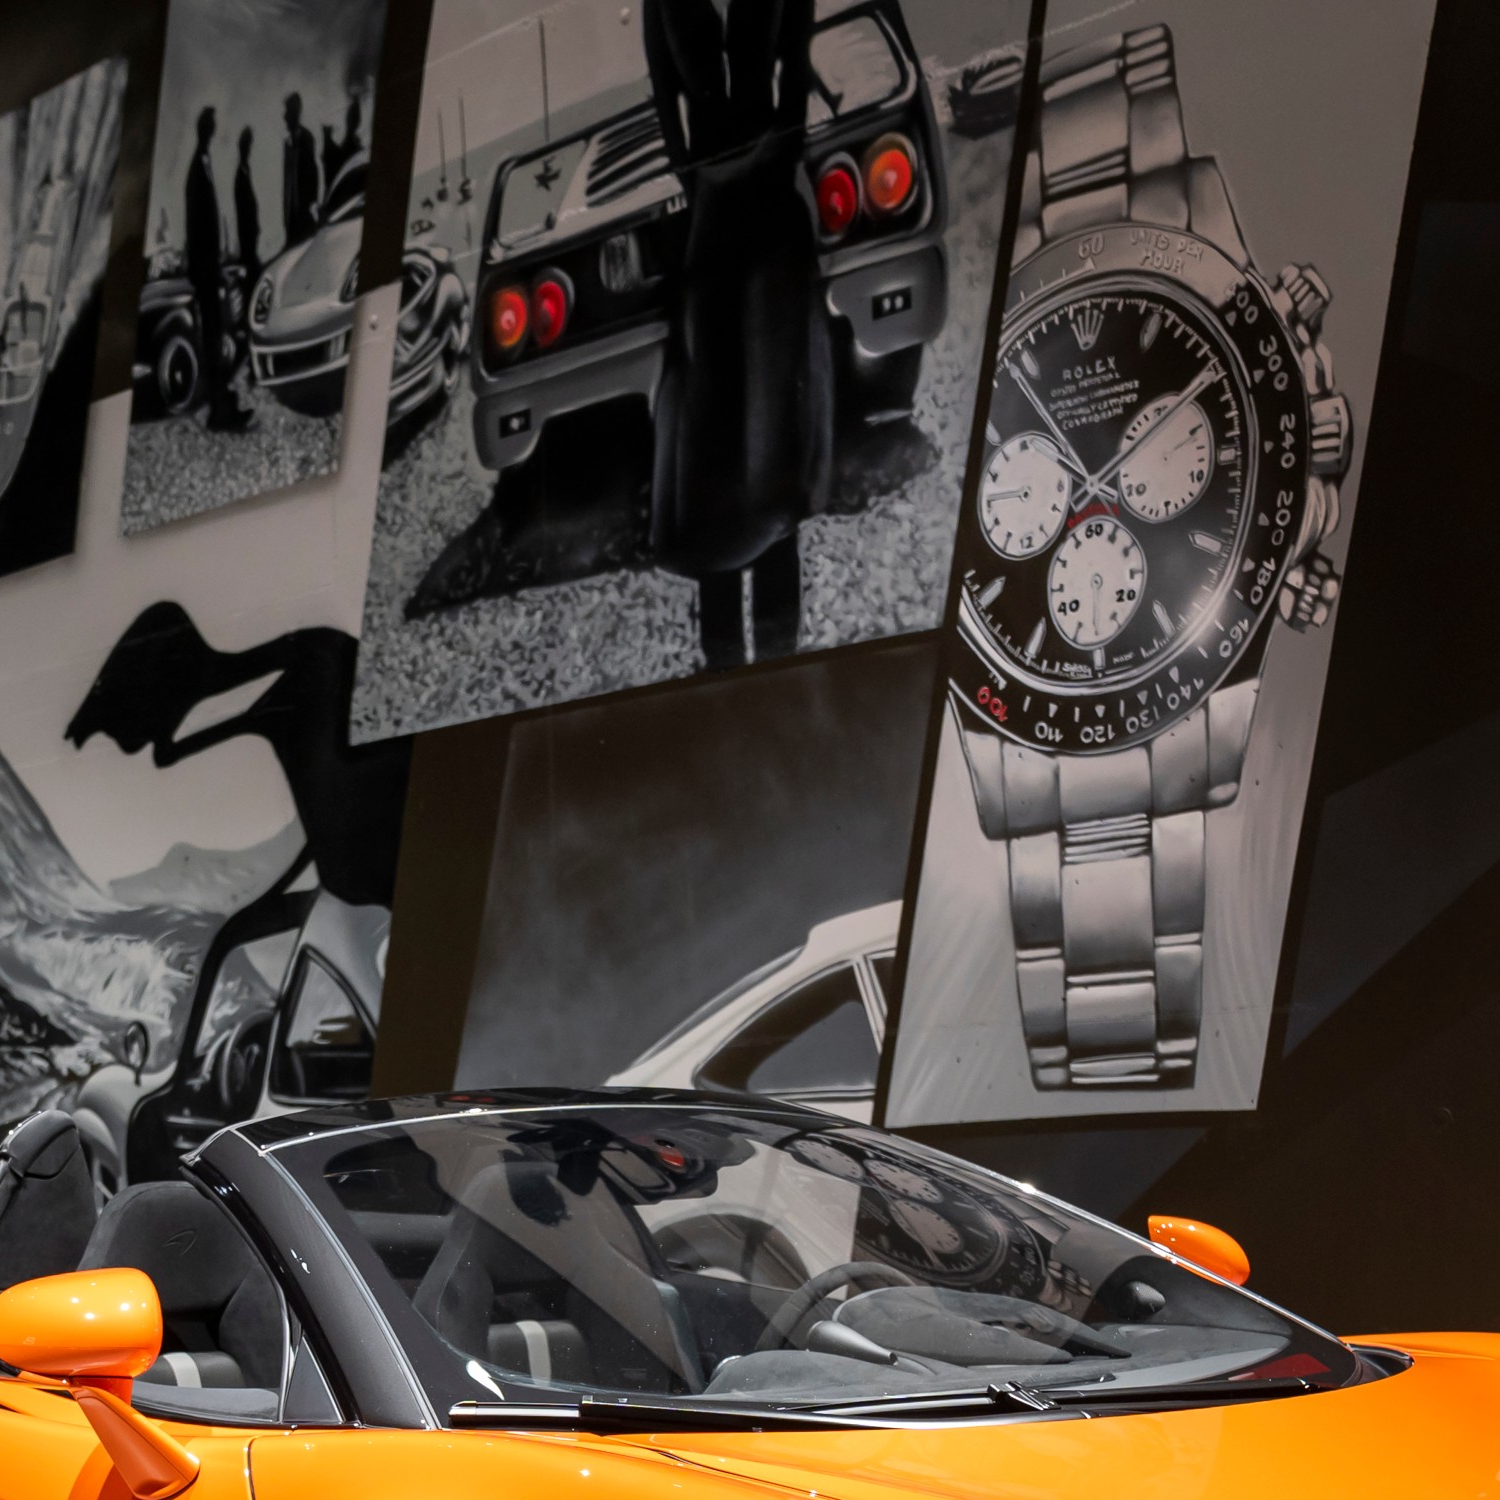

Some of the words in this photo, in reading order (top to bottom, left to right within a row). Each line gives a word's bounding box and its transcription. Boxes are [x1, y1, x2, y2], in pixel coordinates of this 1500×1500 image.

[1078, 233, 1104, 260] 60
[1062, 355, 1116, 381] ROLEX
[1259, 334, 1289, 391] 300
[1280, 413, 1296, 469] 240
[1085, 523, 1103, 539] 60
[1271, 490, 1294, 546] 200
[1251, 557, 1276, 605] 180
[1058, 599, 1080, 616] 40
[1115, 588, 1136, 603] 20
[1219, 618, 1249, 658] 160
[1167, 678, 1204, 710] 140
[1035, 721, 1064, 743] 110
[1080, 723, 1116, 744] 120
[1126, 705, 1160, 734] 130
